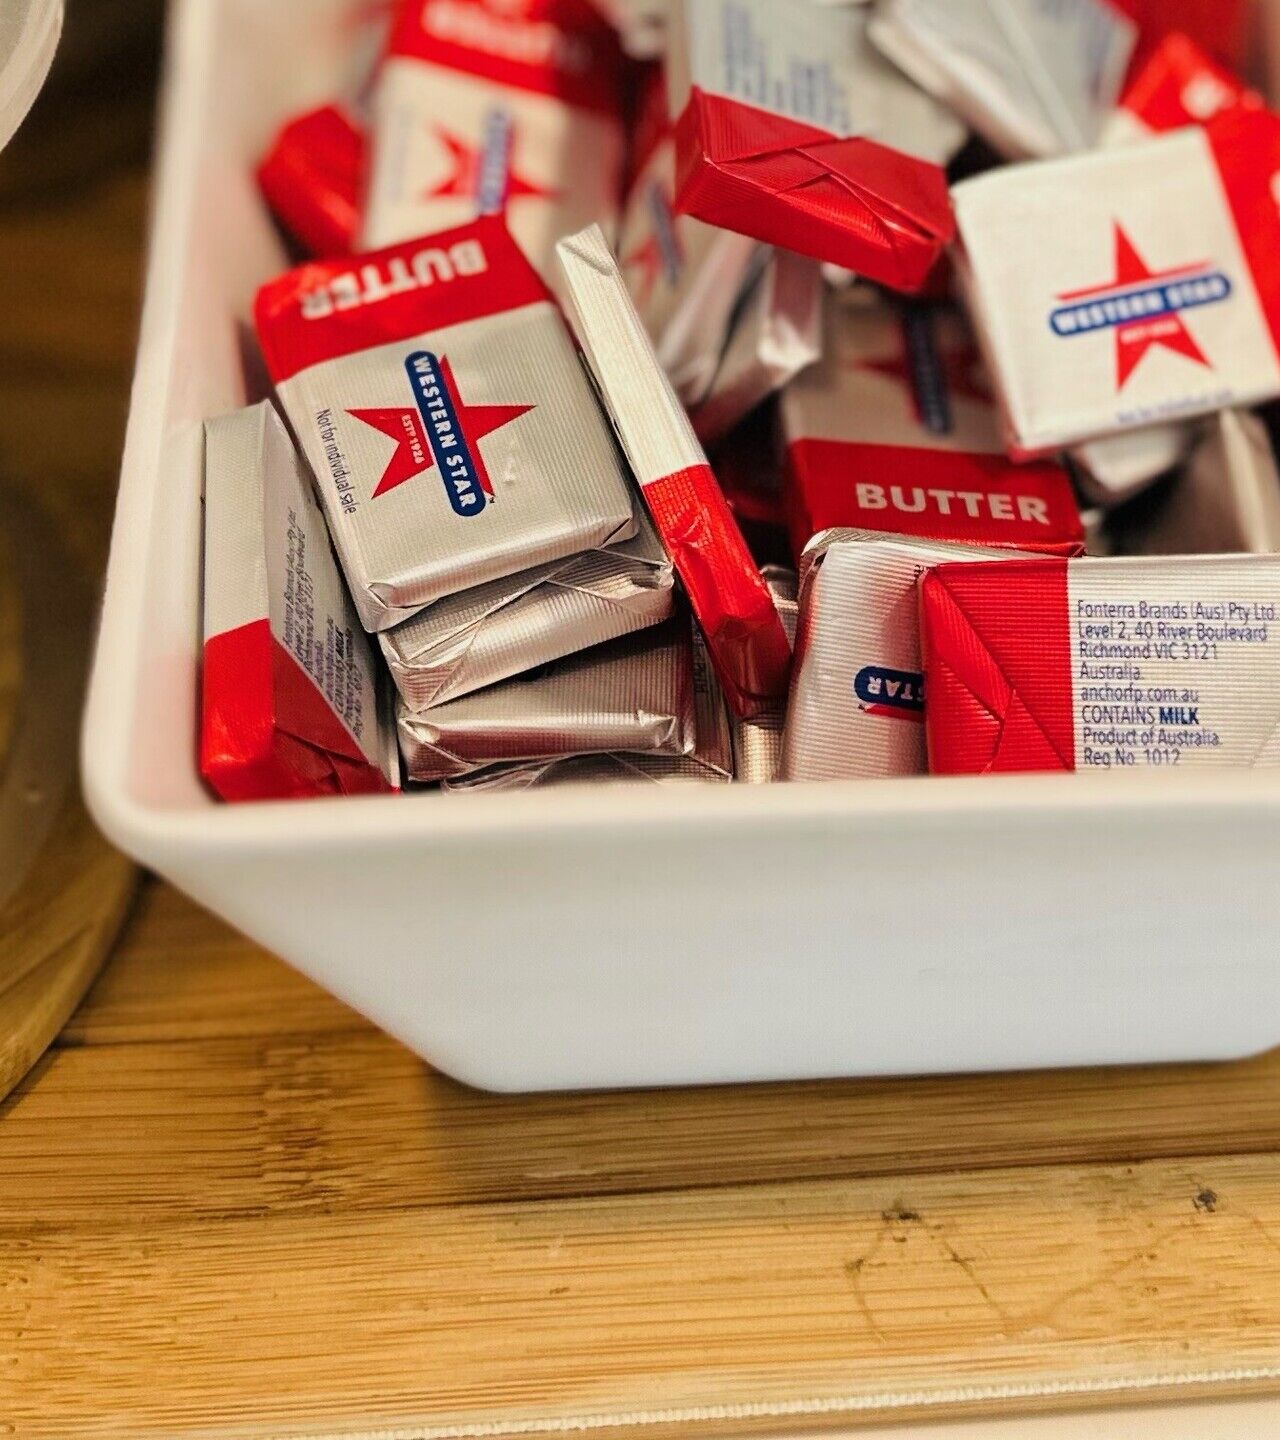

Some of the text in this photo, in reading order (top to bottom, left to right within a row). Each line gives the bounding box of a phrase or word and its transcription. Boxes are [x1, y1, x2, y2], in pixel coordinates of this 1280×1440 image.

[299, 238, 489, 321] BUTTER
[412, 354, 478, 509] WESTERN STAR
[315, 407, 358, 515] Not for individual sale
[408, 438, 426, 465] 1926
[854, 481, 1052, 526] BUTTER
[1076, 599, 1280, 625] Fonterra Brands (Aus) Pty Ltd.
[1077, 621, 1268, 642] Level 2, 40 River Boulevard
[1079, 641, 1219, 660] Richmond VIC 3121
[866, 674, 925, 703] TAR
[1081, 705, 1200, 726] CONTAINS MILK
[1082, 726, 1137, 746] Product
[1139, 726, 1155, 746] of
[1083, 747, 1112, 769] Reg
[1143, 748, 1182, 767] 1012
